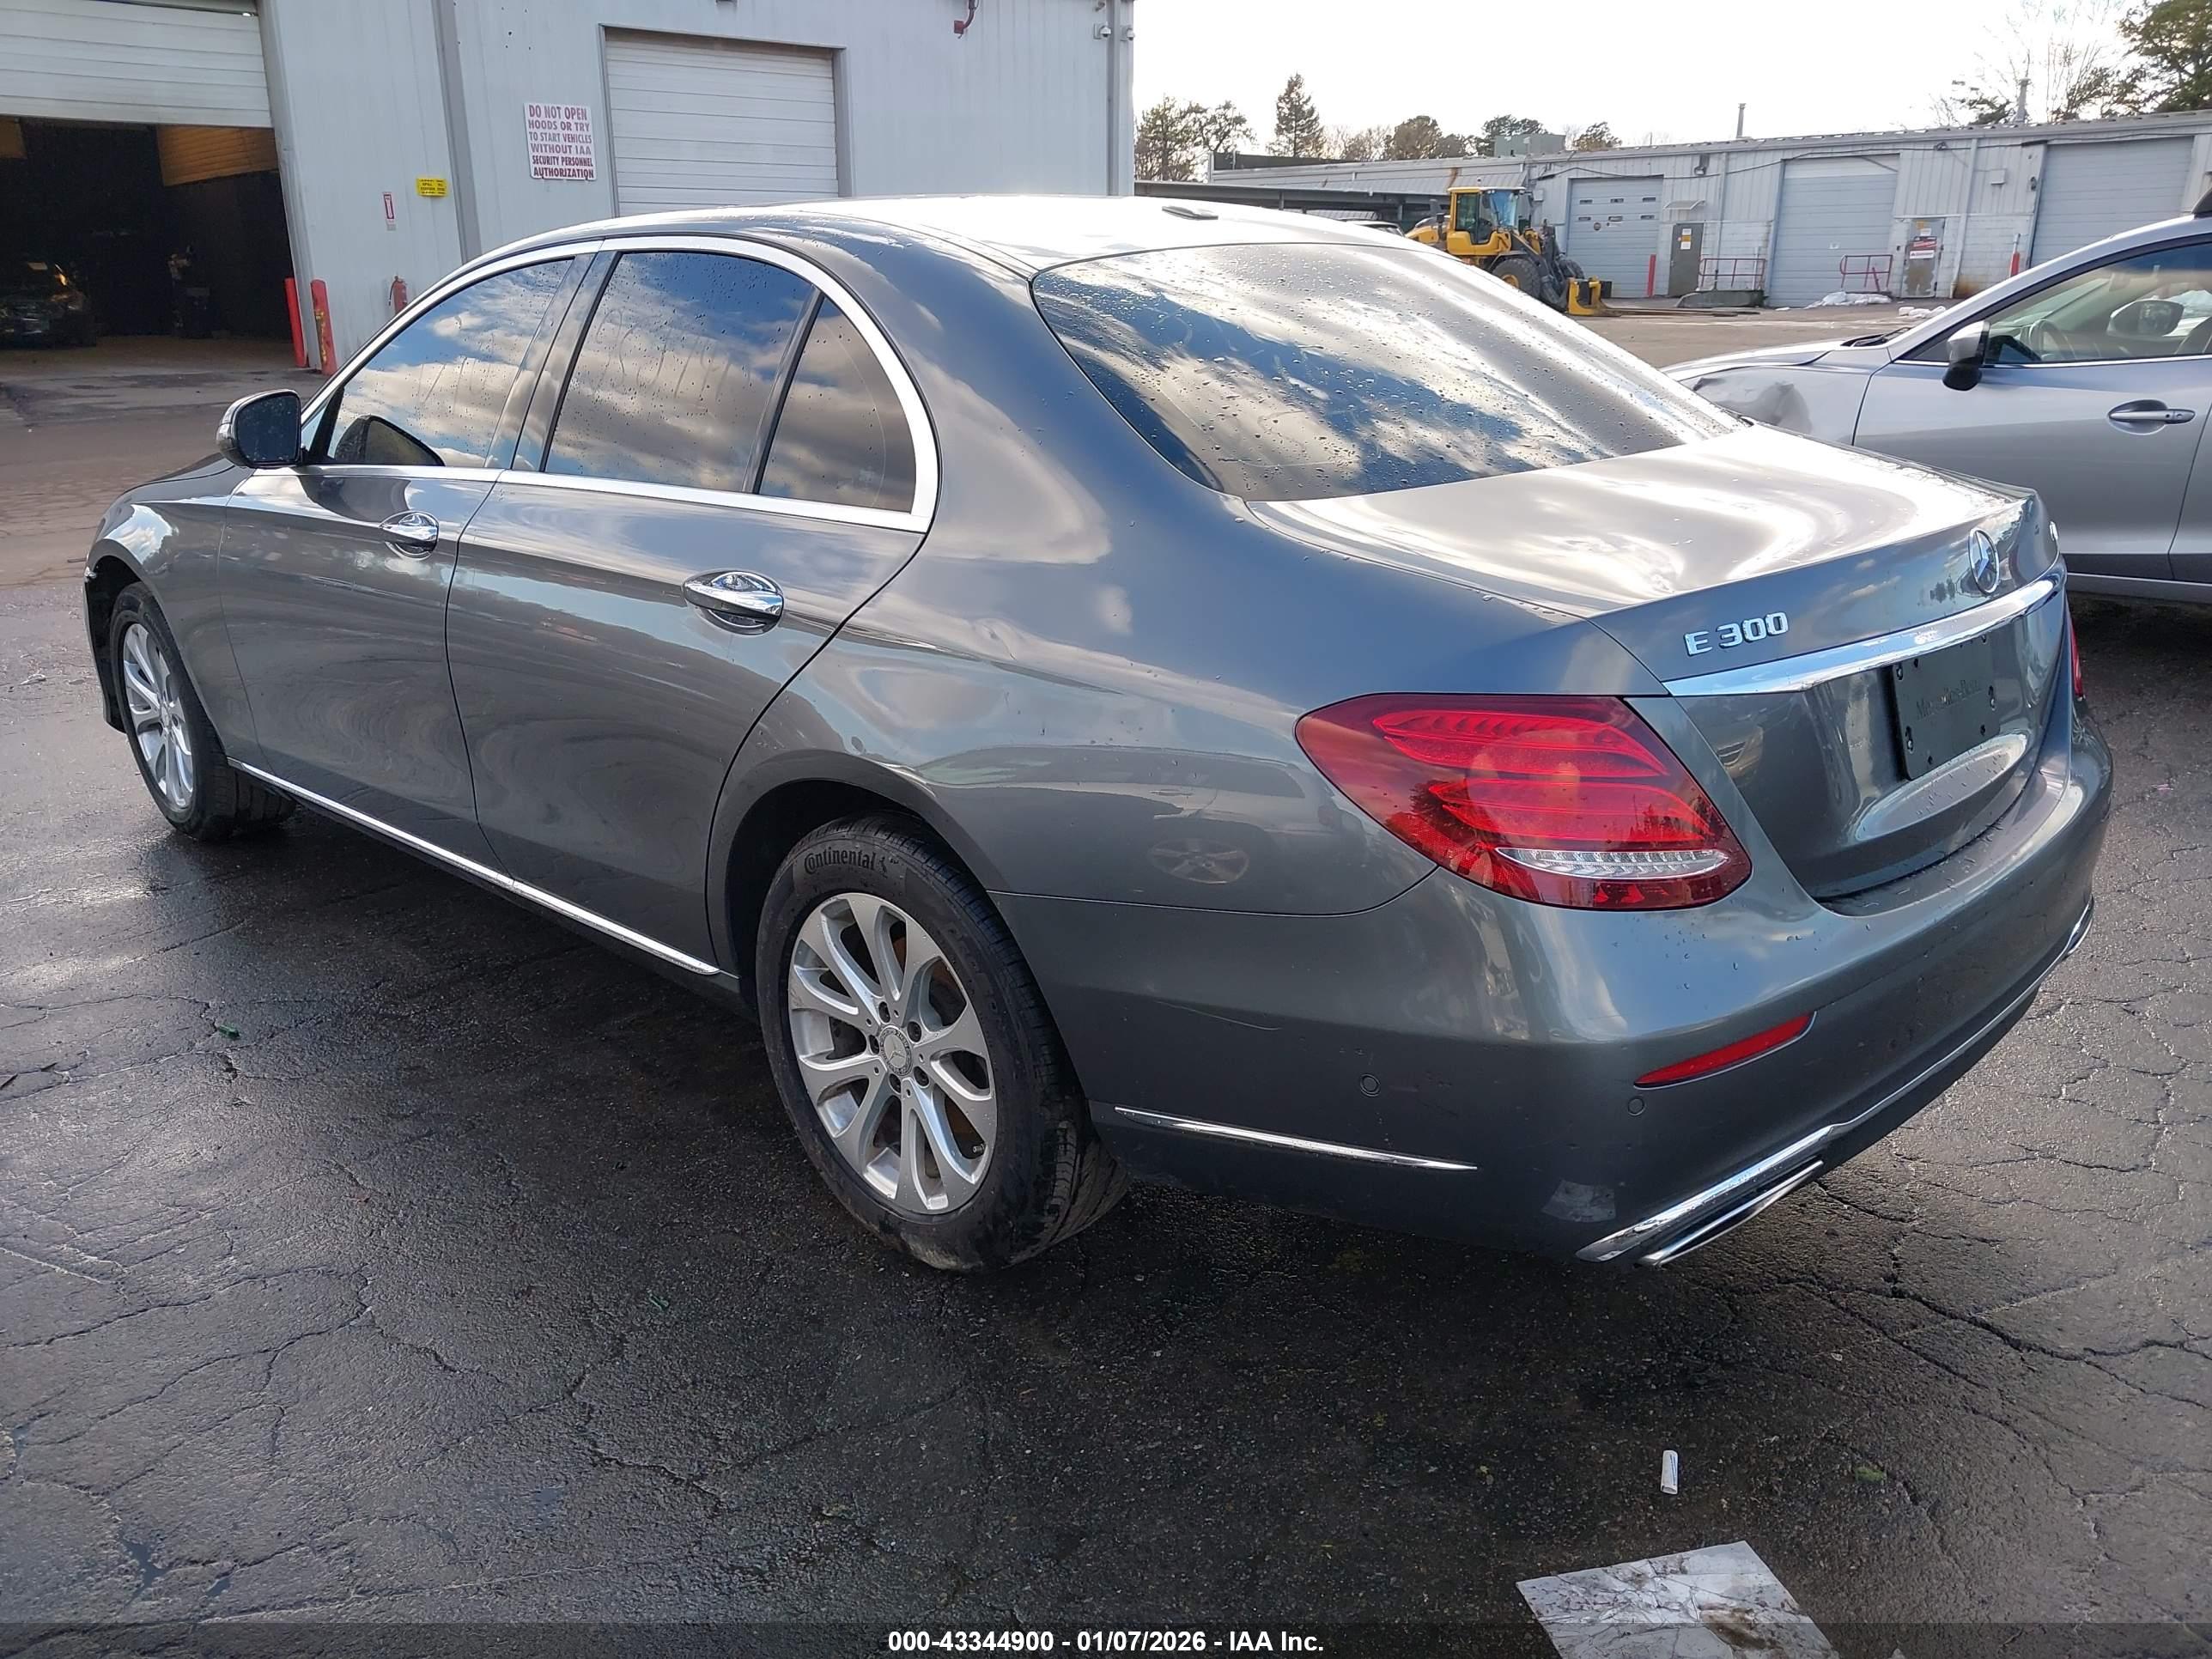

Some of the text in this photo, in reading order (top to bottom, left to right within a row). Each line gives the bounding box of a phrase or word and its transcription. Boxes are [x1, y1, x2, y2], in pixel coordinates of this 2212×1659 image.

[529, 105, 587, 120] DO NOT OPEN
[528, 119, 590, 131] HOODS OR TRY
[529, 131, 592, 143] TO START VEHICLES
[530, 143, 592, 155] WITHOUT IAA
[532, 155, 593, 167] SECURITY PERSONNEL
[533, 167, 594, 179] AUTHORIZATION
[1684, 611, 1789, 656] E 300
[804, 847, 876, 874] Continental
